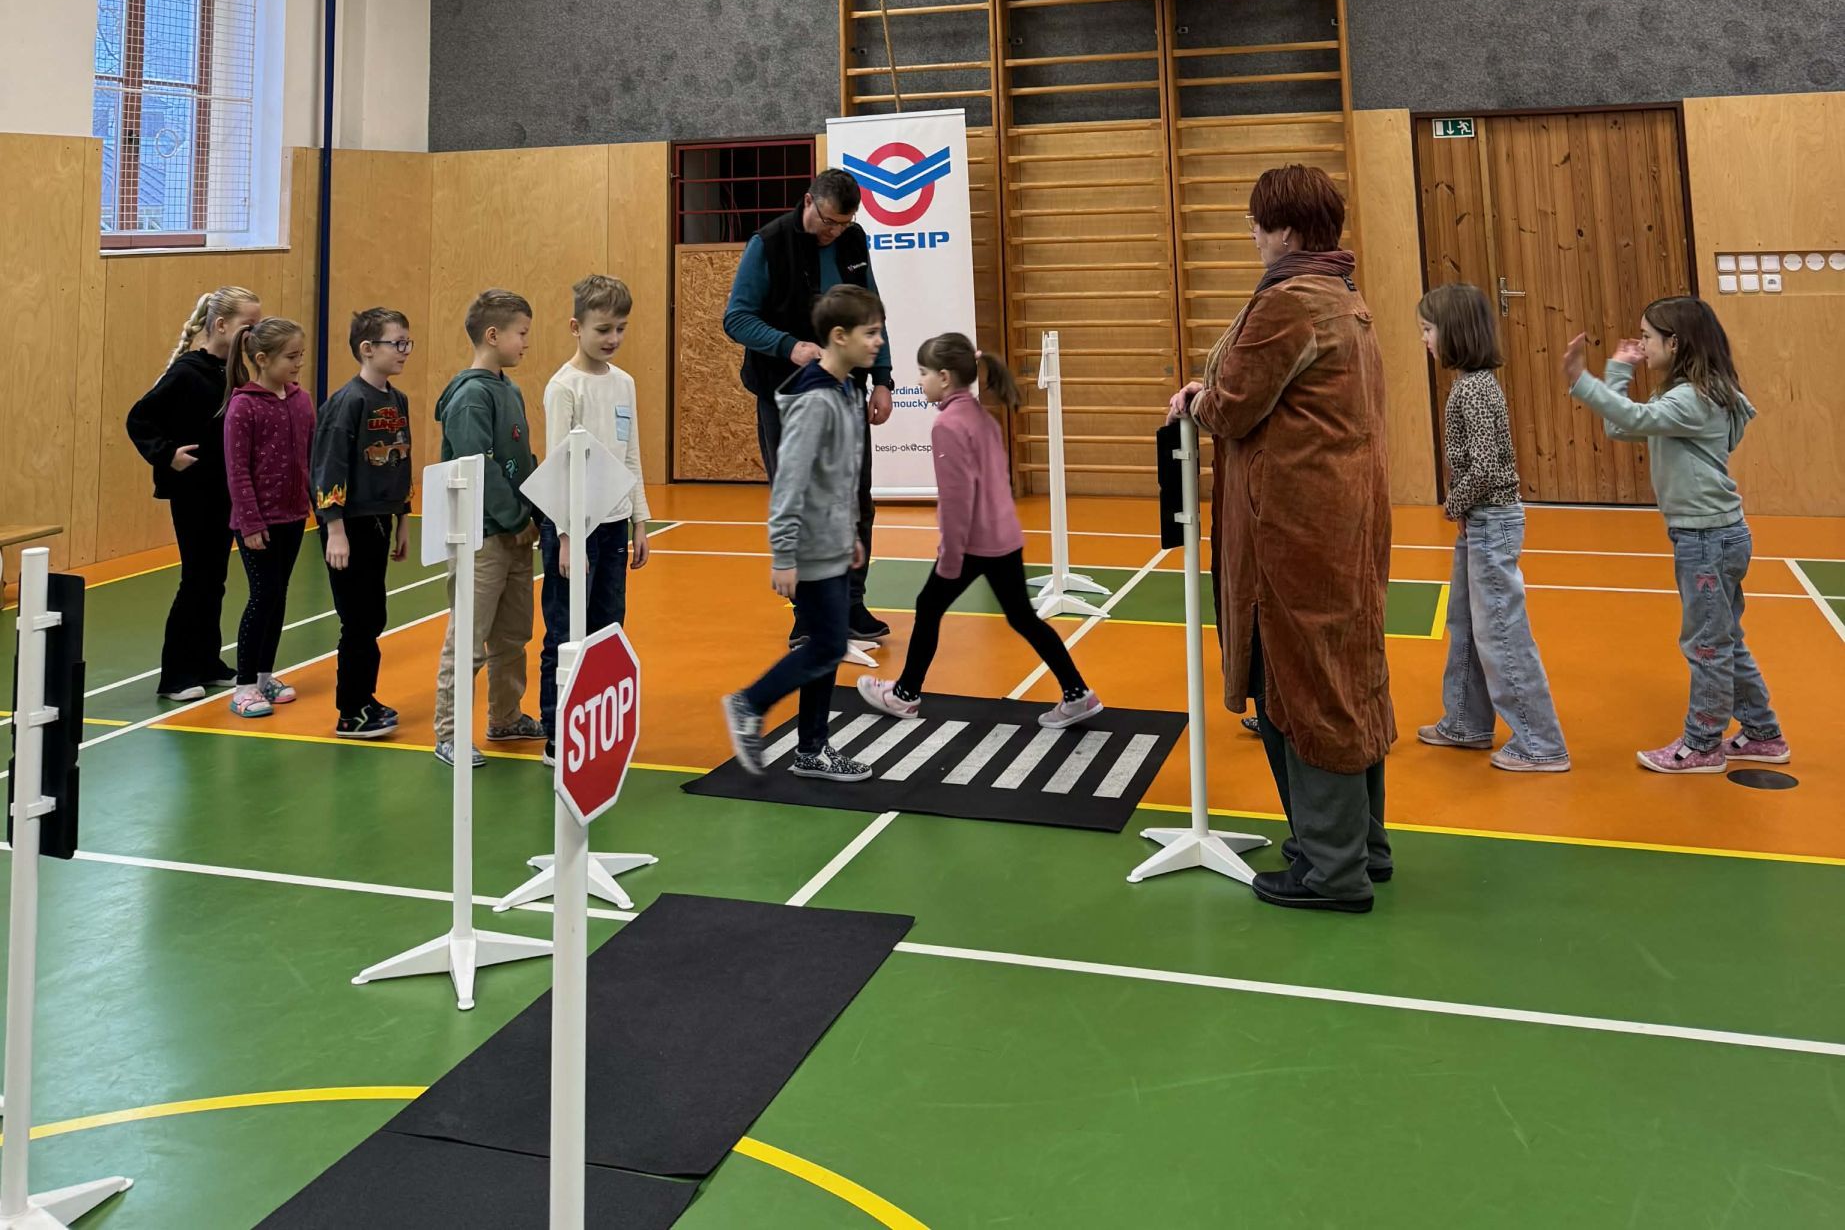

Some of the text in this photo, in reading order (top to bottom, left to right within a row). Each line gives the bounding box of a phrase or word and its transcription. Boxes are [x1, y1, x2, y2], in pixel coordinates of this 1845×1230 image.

[866, 231, 950, 251] ESIP
[892, 399, 929, 410] moucký
[875, 443, 932, 454] besip-ok@csp
[568, 676, 634, 773] STOP
